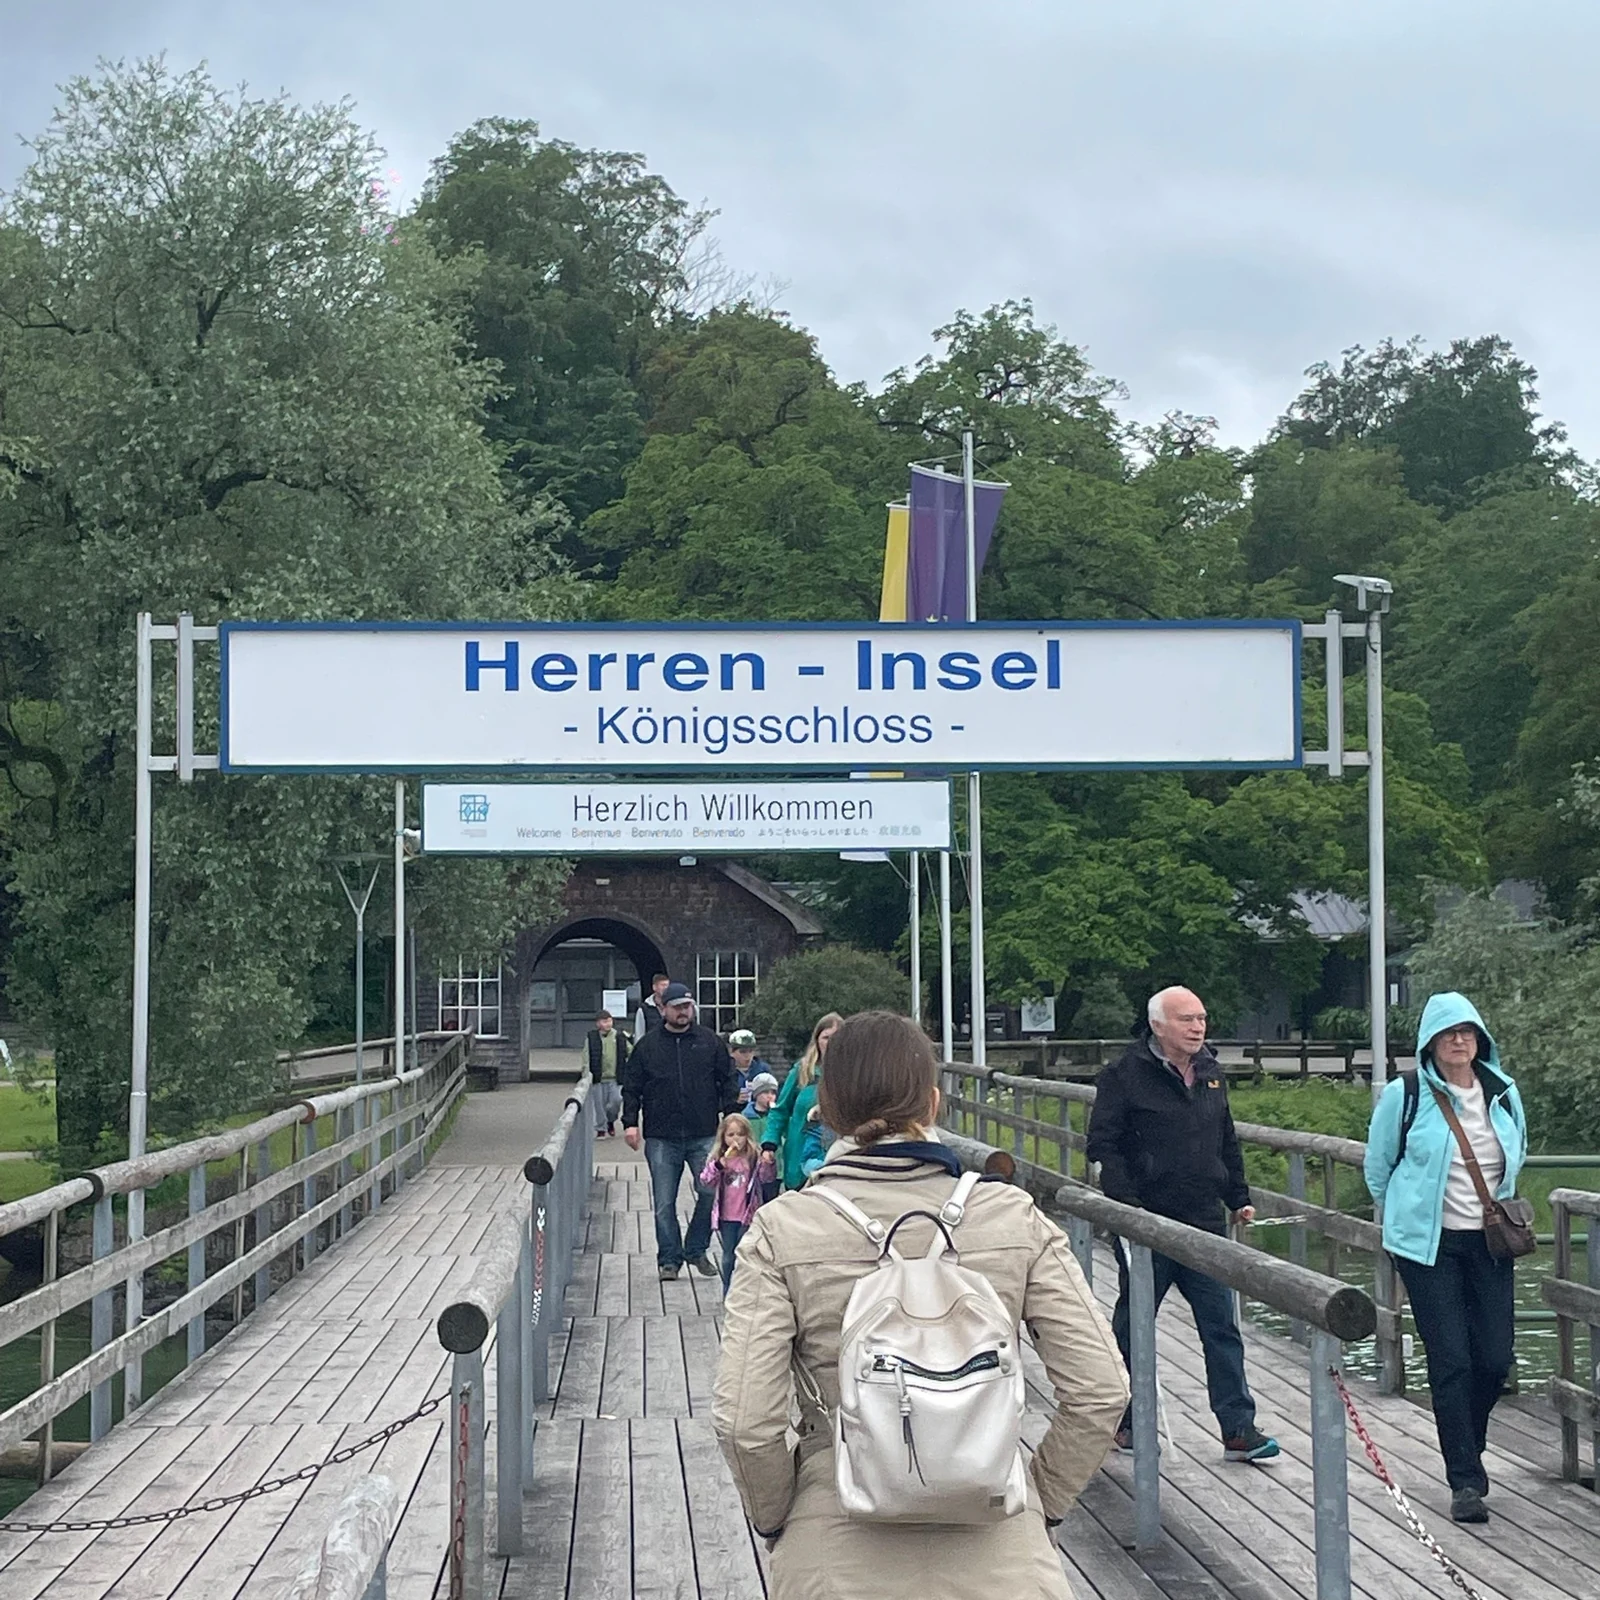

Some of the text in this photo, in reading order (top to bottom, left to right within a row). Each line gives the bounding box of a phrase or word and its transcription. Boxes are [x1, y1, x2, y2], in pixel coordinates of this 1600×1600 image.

[465, 641, 765, 692] Herren
[856, 639, 1061, 691] Insel
[598, 705, 933, 755] Königsschloss
[574, 794, 873, 822] Herzlich Willkommen
[516, 826, 745, 838] Welcome Bienvenue Benvenuto Bienvenido
